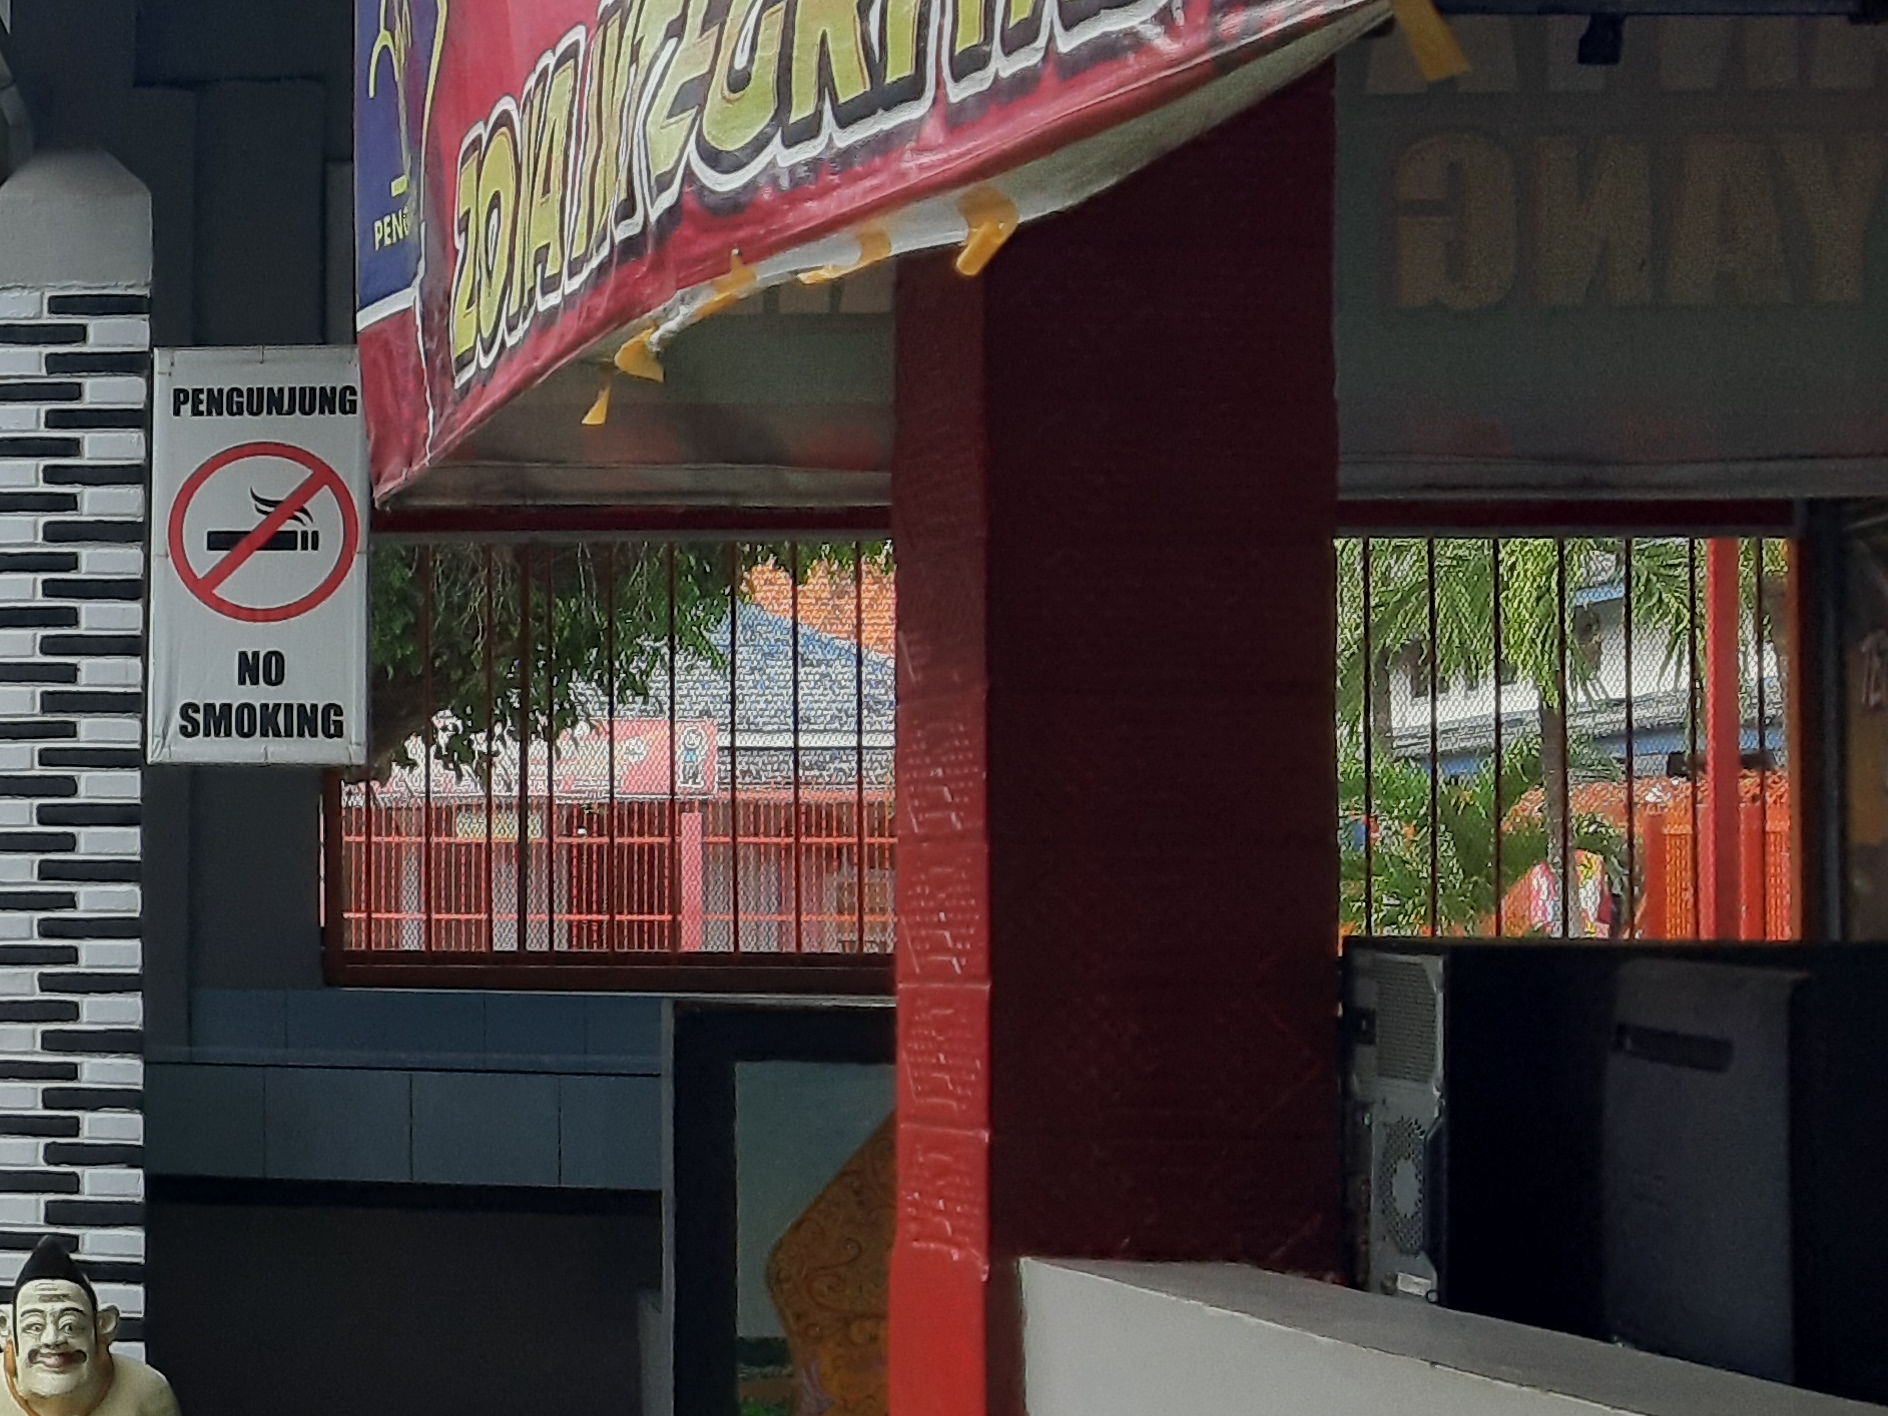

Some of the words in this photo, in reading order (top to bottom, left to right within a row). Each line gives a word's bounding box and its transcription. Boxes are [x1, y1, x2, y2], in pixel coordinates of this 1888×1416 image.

[452, 44, 582, 372] ZONA
[172, 385, 359, 417] PENGUNJUNG
[237, 650, 285, 686] NO
[179, 701, 344, 739] SMOKING
